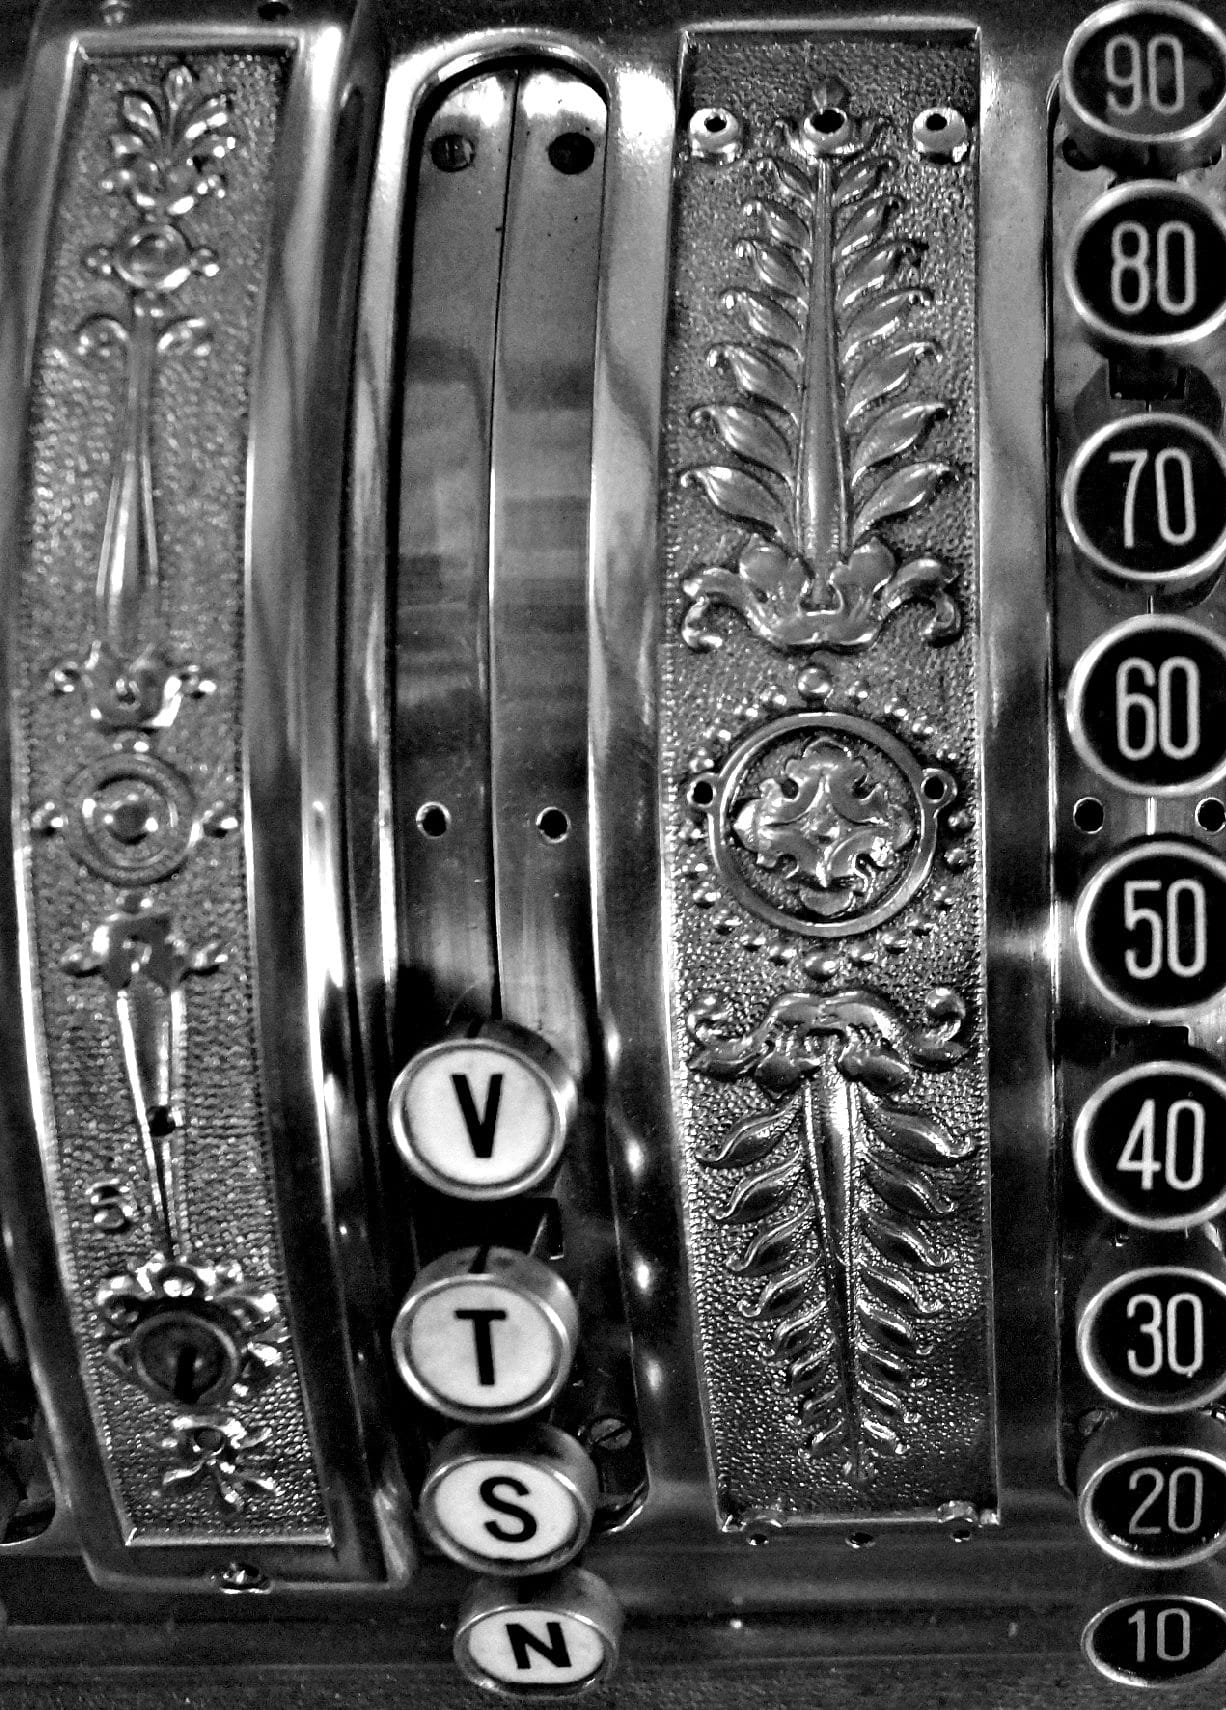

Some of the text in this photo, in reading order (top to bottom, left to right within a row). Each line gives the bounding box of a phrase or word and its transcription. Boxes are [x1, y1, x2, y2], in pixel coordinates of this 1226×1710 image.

[1103, 34, 1185, 115] 90
[1109, 220, 1196, 315] 80
[1109, 448, 1196, 548] 70
[1115, 656, 1200, 760] 60
[1123, 879, 1208, 980] 50
[452, 1073, 503, 1159] V
[1117, 1100, 1205, 1191] 40
[456, 1309, 506, 1385] T
[1127, 1294, 1204, 1378] 30
[479, 1476, 537, 1543] S
[1128, 1466, 1204, 1535] 20
[506, 1622, 570, 1669] N
[1127, 1608, 1191, 1663] 10
